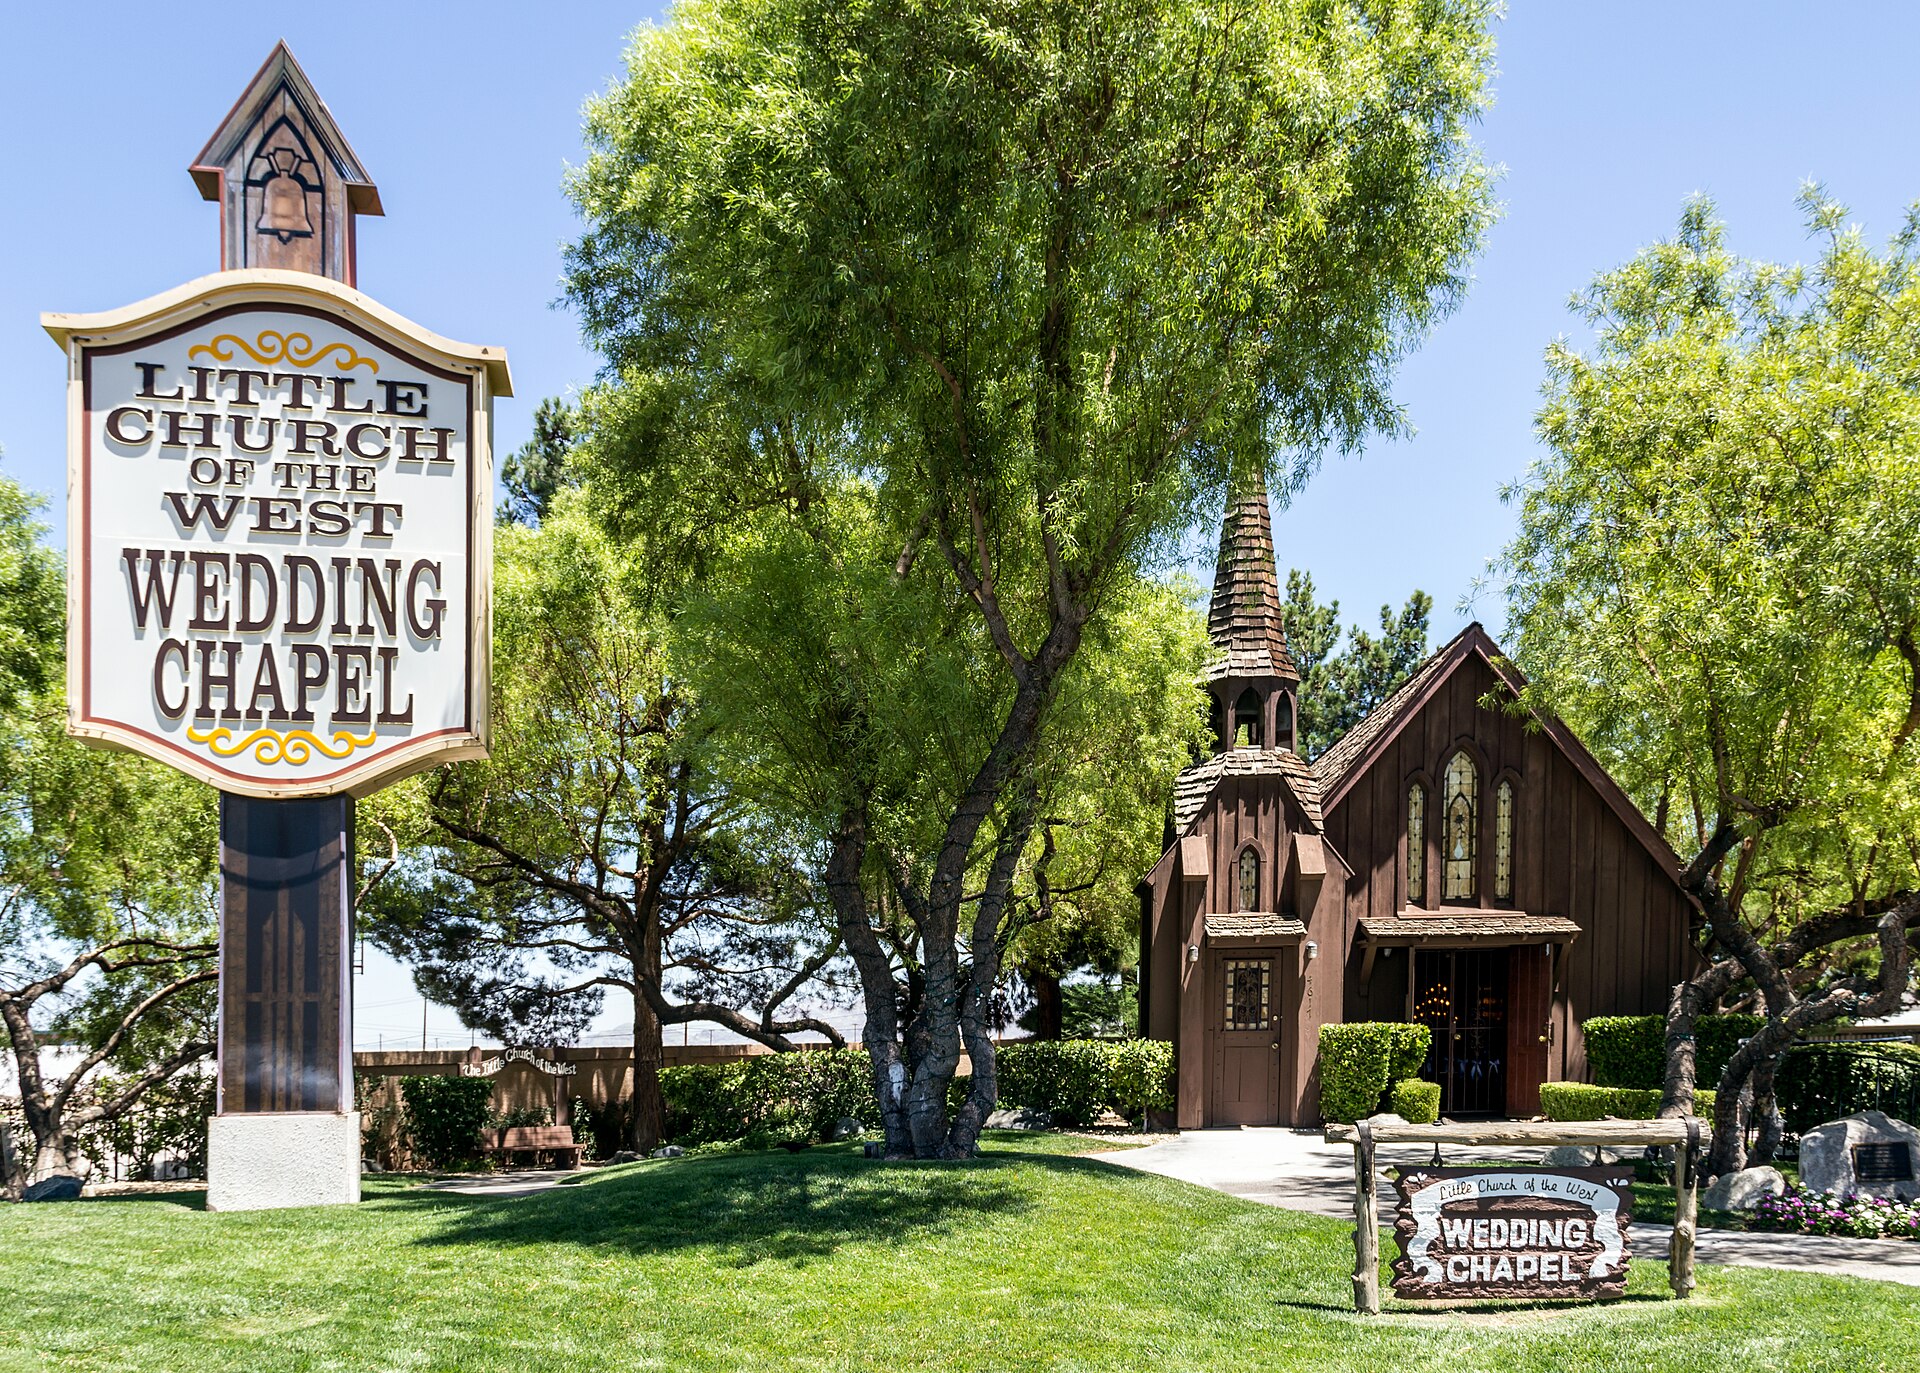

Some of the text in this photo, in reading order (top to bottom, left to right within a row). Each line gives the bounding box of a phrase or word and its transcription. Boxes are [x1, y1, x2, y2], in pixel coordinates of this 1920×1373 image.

[135, 362, 429, 418] LITTLE
[106, 407, 456, 464] CHURCH
[190, 457, 377, 493] OF THE
[164, 492, 403, 539] WEST
[121, 547, 447, 640] WEDDING
[154, 638, 413, 725] CHAPEL
[463, 1047, 577, 1077] The Little Church of the West
[1439, 1177, 1599, 1201] Little Church of the West
[1442, 1218, 1588, 1249] WEDDING
[1446, 1254, 1582, 1283] CHAPEL
